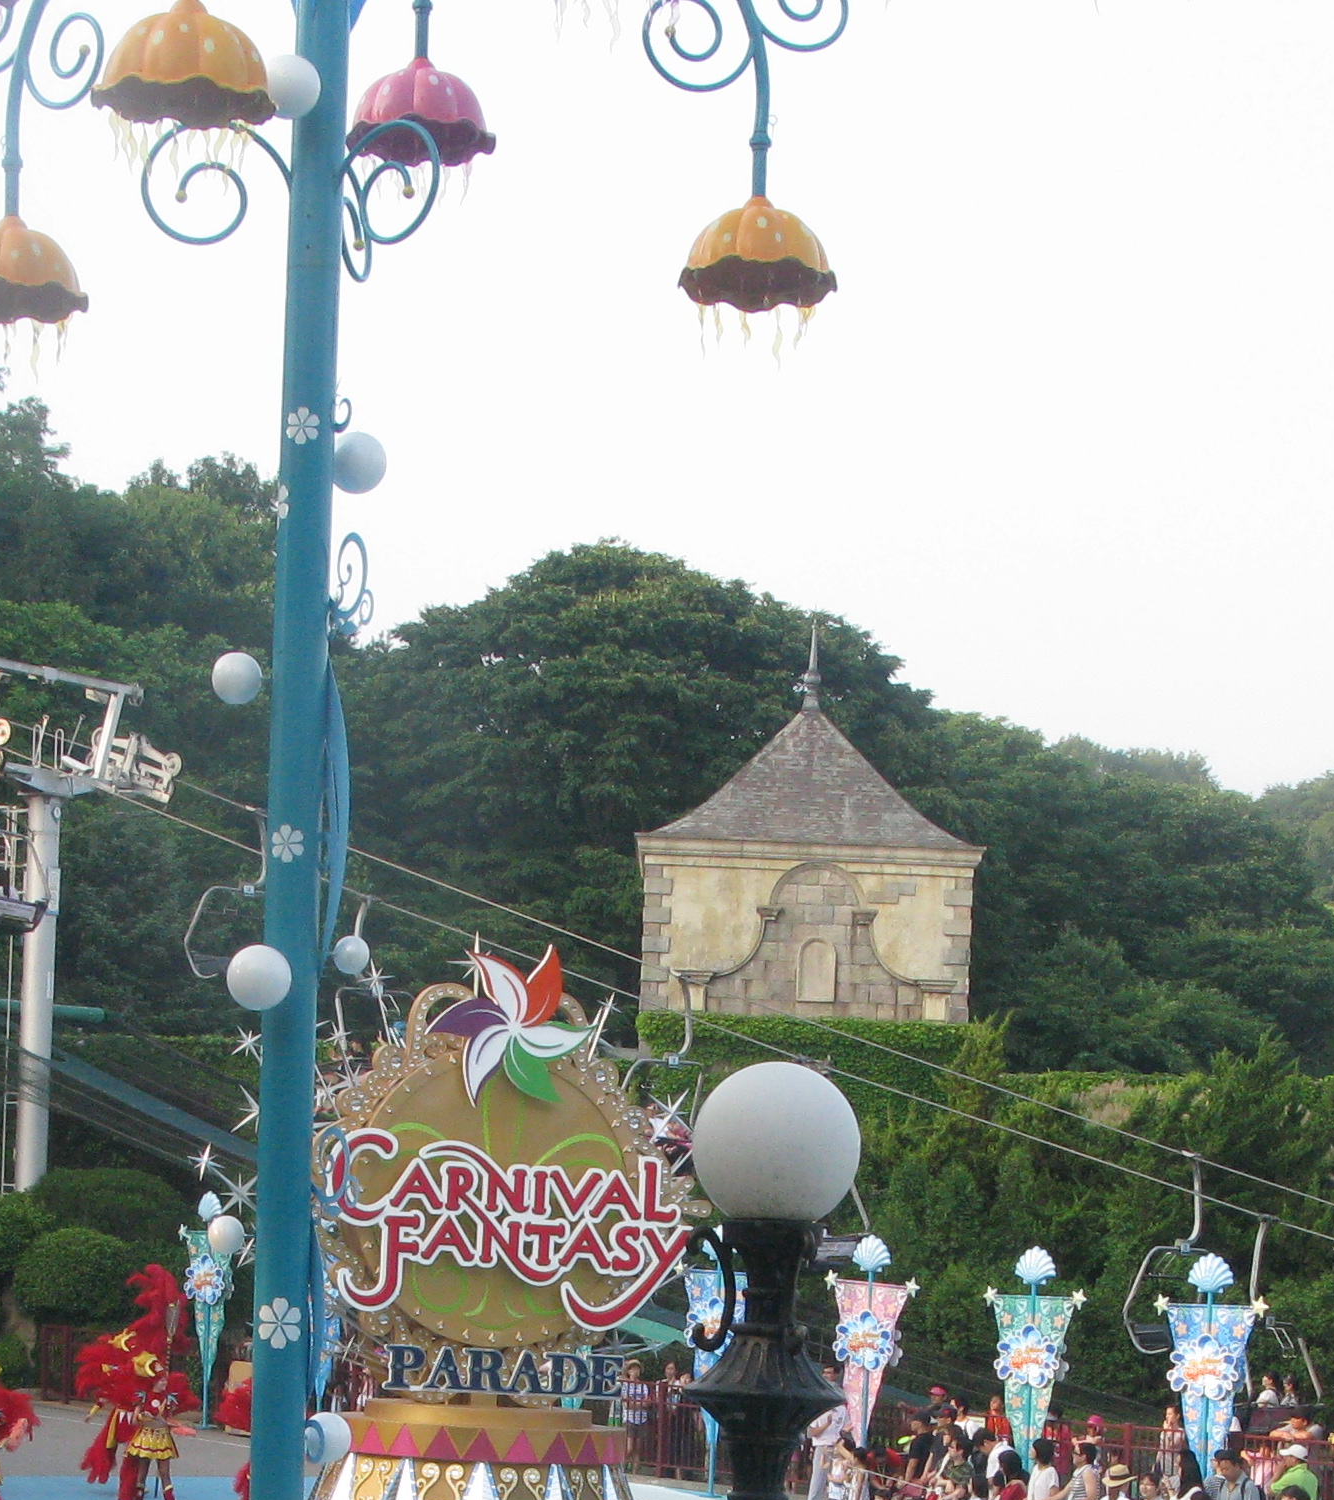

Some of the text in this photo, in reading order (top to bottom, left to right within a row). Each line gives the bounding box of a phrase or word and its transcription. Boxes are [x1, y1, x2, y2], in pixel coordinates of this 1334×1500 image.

[324, 1127, 682, 1231] CARNIVAL
[337, 1212, 693, 1332] FANTASY
[382, 1343, 624, 1398] PARADE
